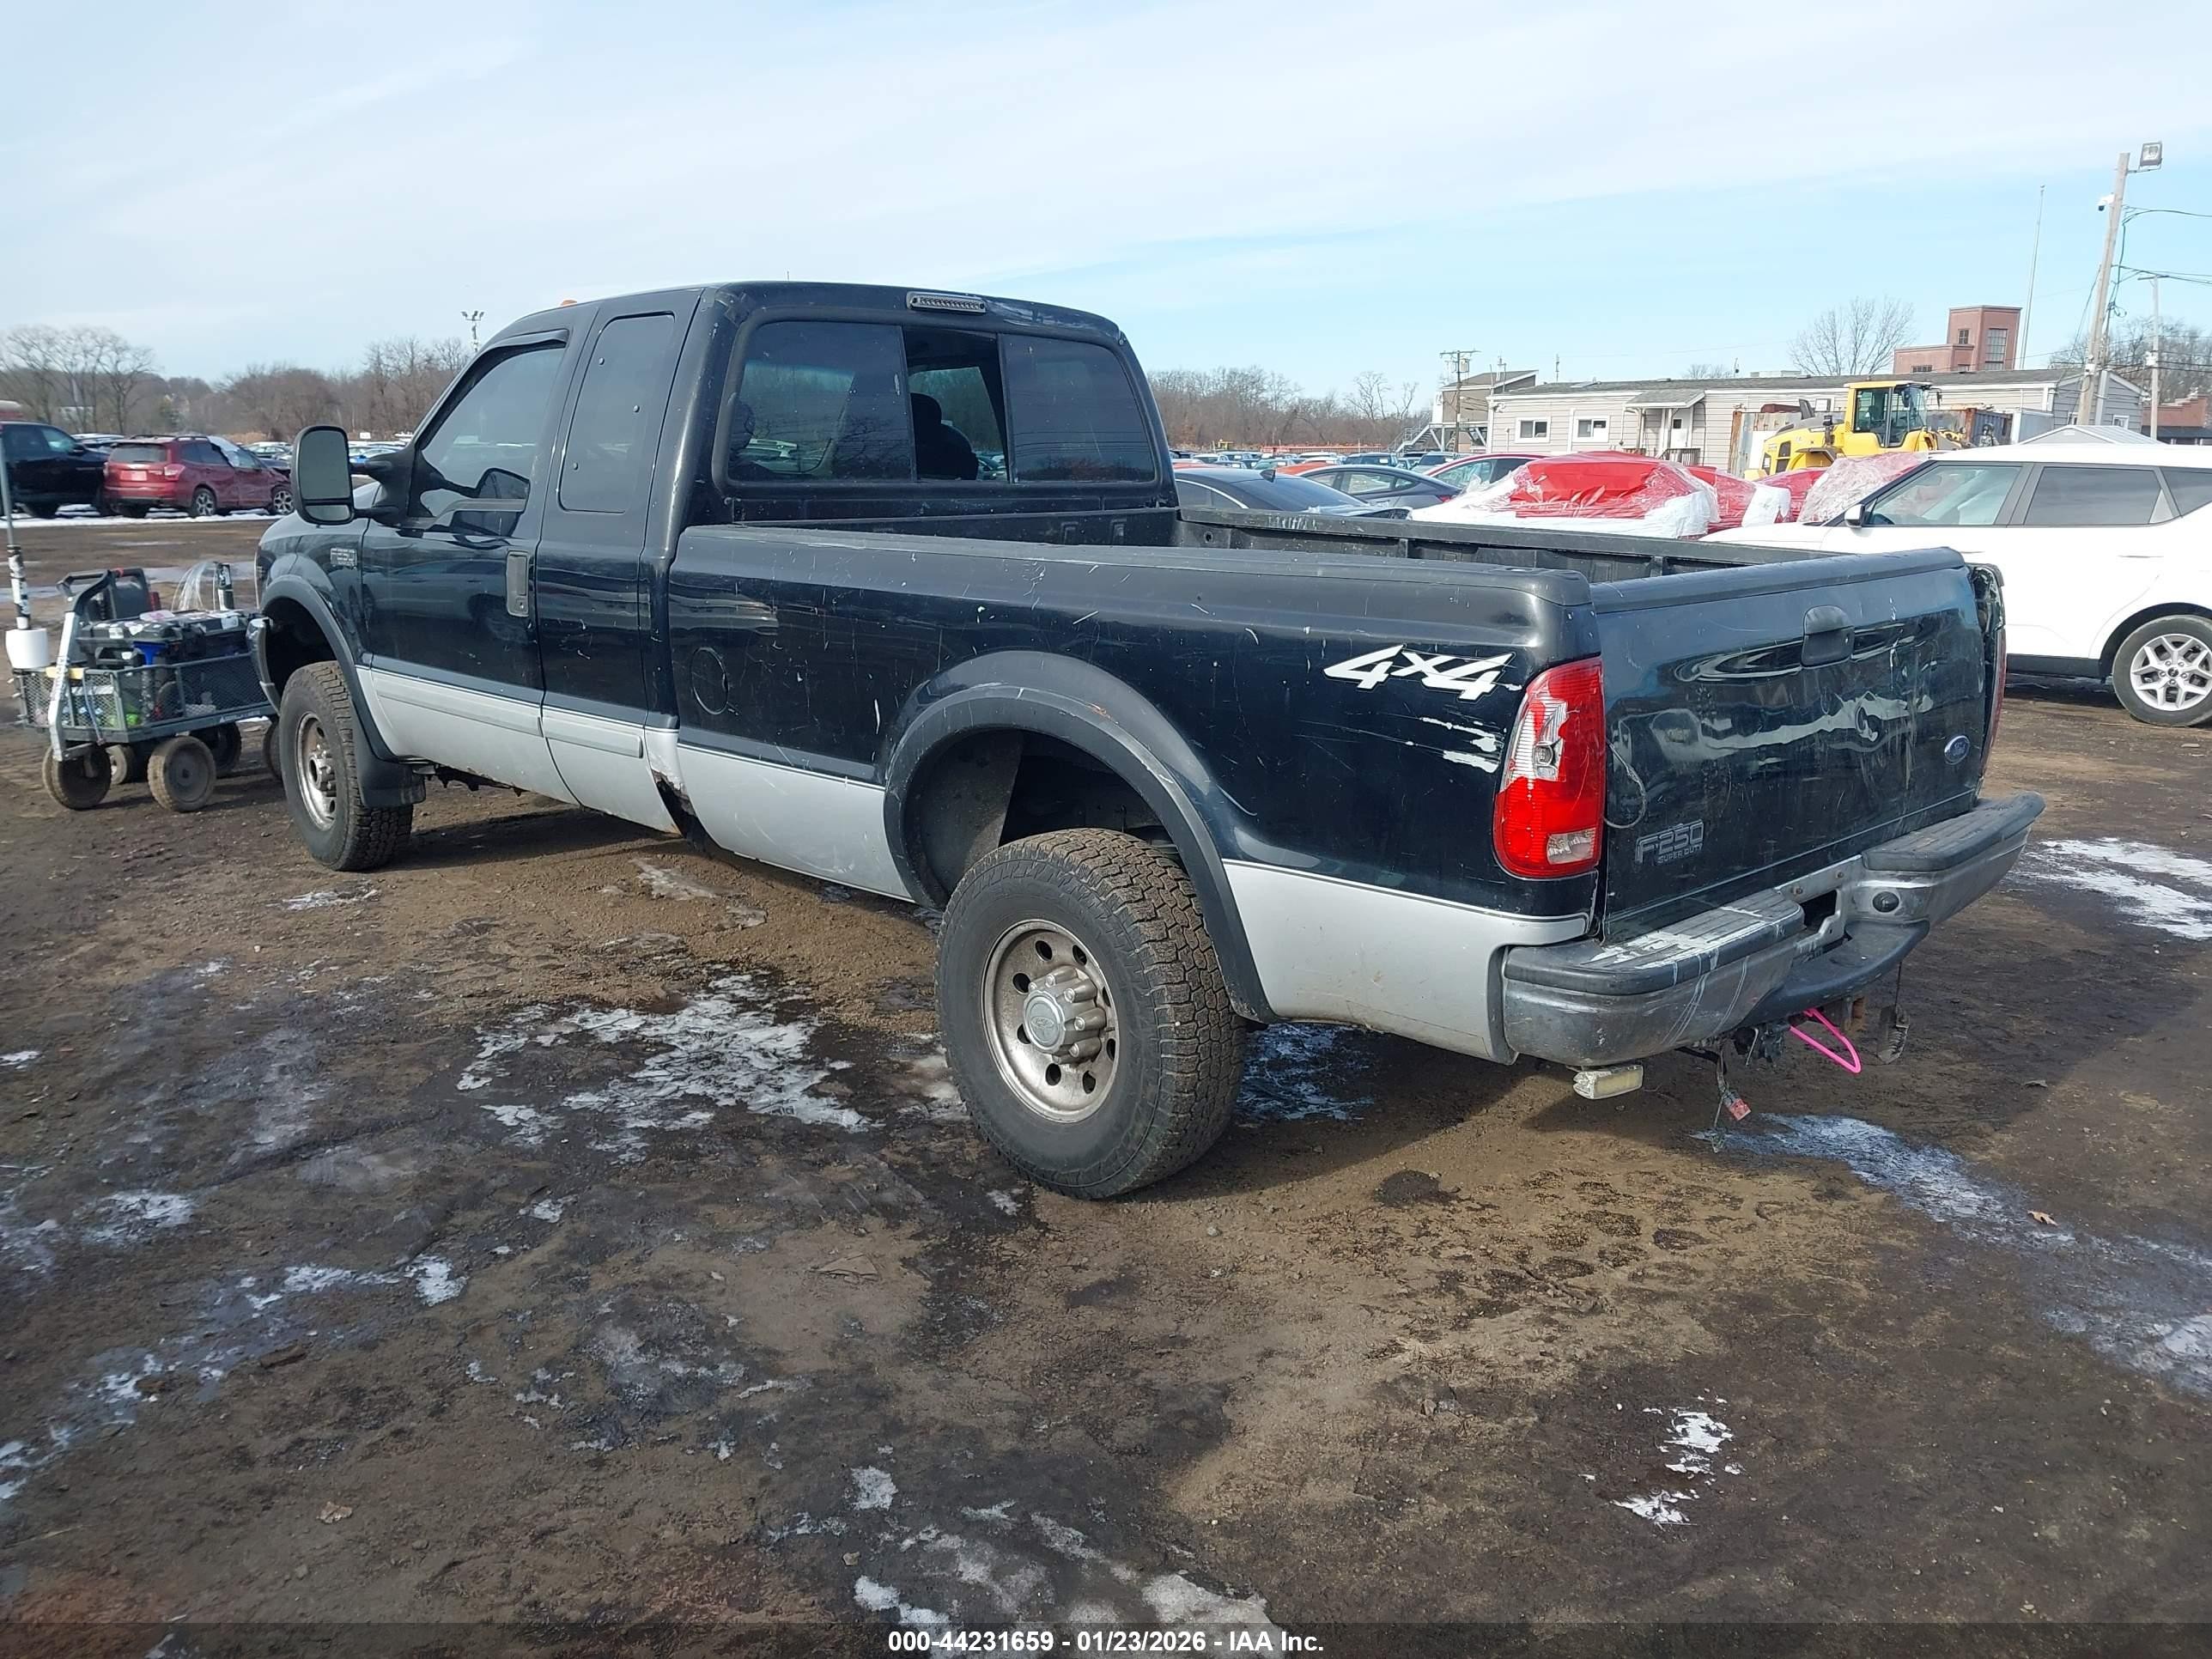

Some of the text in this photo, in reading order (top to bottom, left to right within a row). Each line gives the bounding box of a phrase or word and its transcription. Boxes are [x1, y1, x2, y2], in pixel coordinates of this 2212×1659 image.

[1636, 821, 1704, 863] F250
[1656, 842, 1704, 864] SUPER DUTY
